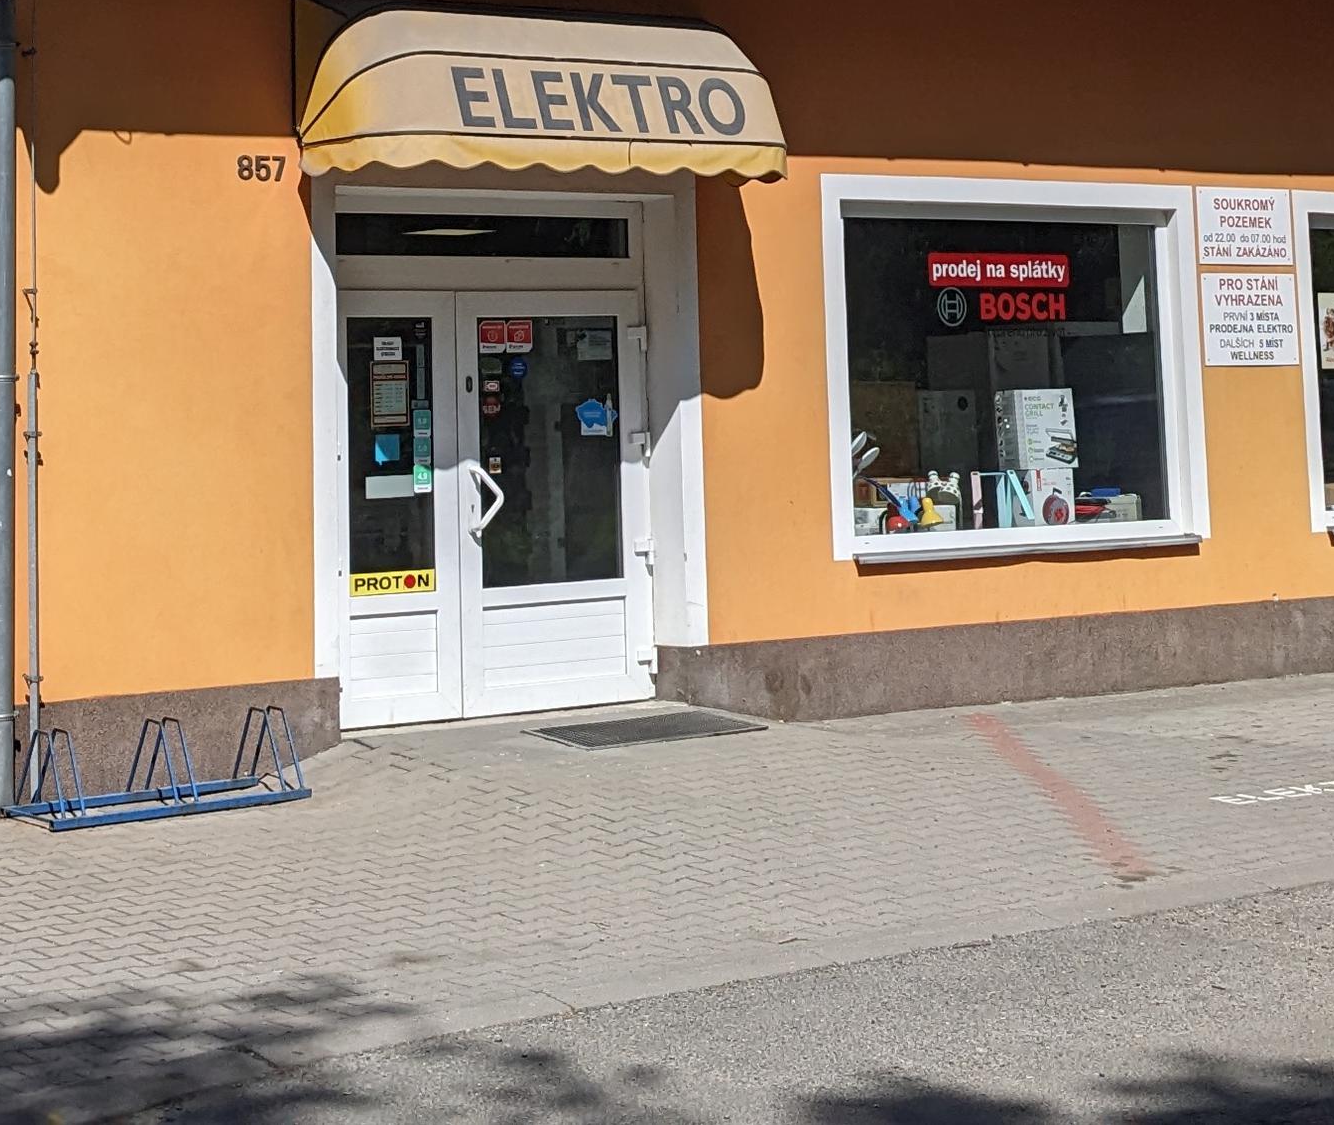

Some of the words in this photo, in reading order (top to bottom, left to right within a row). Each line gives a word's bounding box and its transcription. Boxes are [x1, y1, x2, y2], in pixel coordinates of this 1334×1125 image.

[451, 65, 746, 136] ELEKTRO
[236, 154, 286, 182] 857
[1213, 196, 1275, 211] SOUKROMÝ
[1220, 216, 1272, 228] POZEMEK
[1204, 233, 1213, 242] od
[1215, 233, 1236, 242] 22.00
[1240, 234, 1249, 243] do
[1250, 234, 1271, 243] 07.00
[1272, 234, 1286, 244] hod
[1203, 244, 1232, 257] STÁNÍ
[1236, 245, 1287, 258] ZAKÁZÁNO
[932, 260, 981, 282] prodej
[986, 263, 1005, 278] na
[1010, 260, 1066, 283] splátky
[1219, 278, 1243, 291] PRO
[1246, 276, 1278, 291] STÁNÍ
[979, 292, 1066, 320] BOSCH
[1215, 294, 1283, 306] VYHRAZENA
[1223, 310, 1248, 322] PRVNÍ
[1250, 313, 1255, 322] 3
[1256, 311, 1280, 322] MÍSTA
[1209, 324, 1254, 333] PRODEJNA
[1257, 324, 1293, 333] ELEKTRO
[1219, 337, 1255, 348] DALŠÍCH
[1259, 339, 1264, 348] 5
[1265, 337, 1284, 348] MÍST
[1230, 351, 1275, 360] WELLNESS
[354, 573, 429, 592] PROTON
